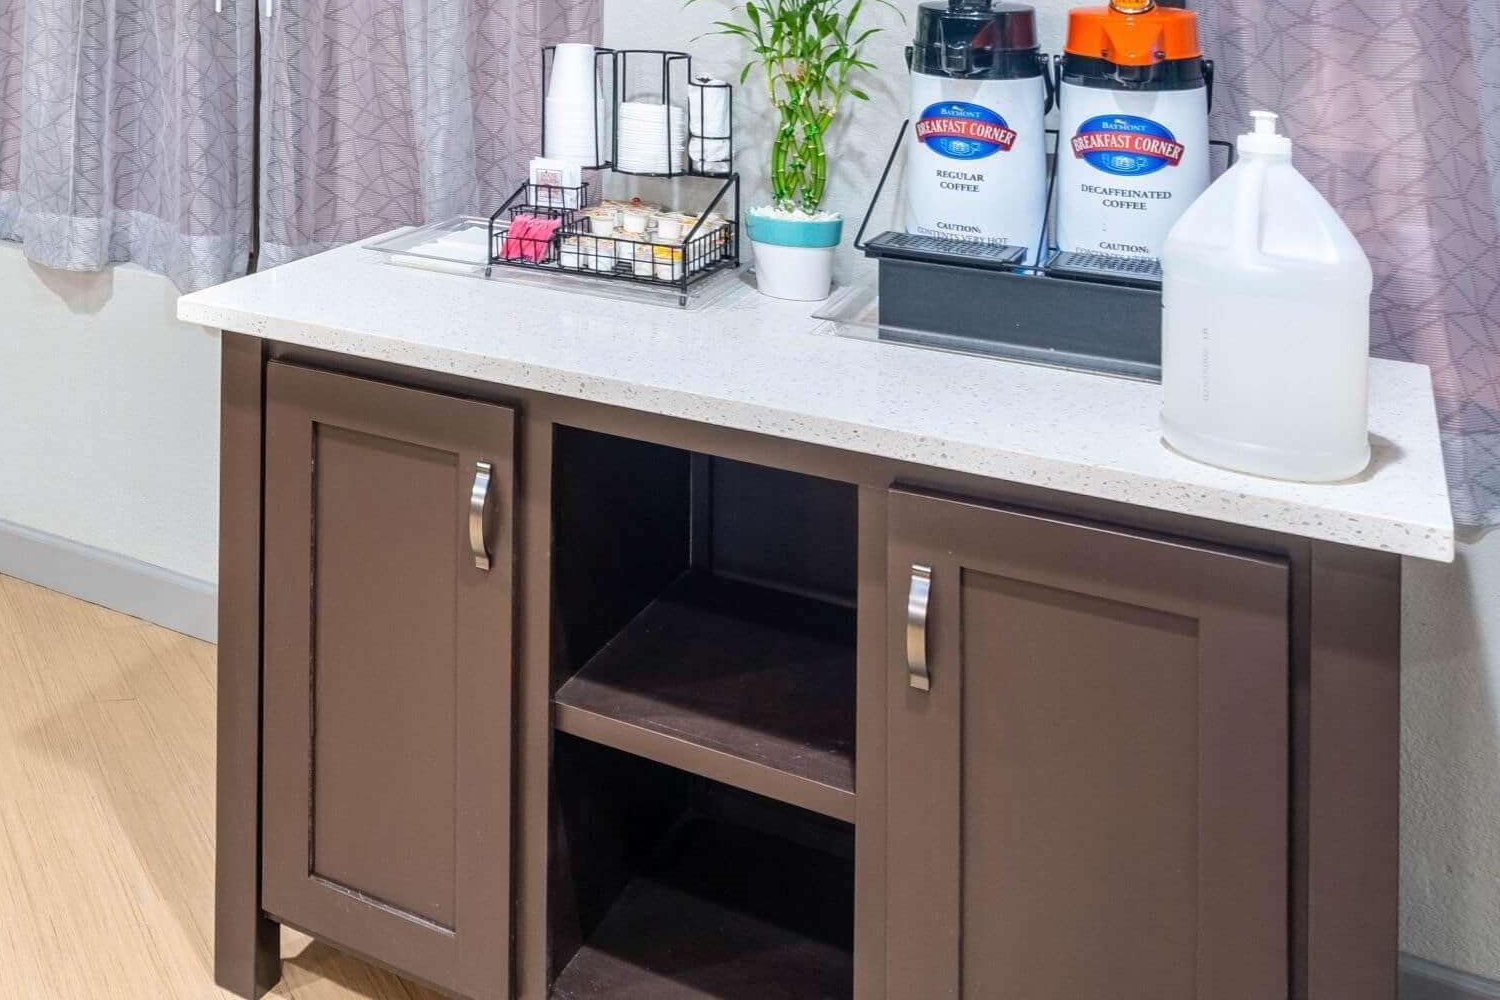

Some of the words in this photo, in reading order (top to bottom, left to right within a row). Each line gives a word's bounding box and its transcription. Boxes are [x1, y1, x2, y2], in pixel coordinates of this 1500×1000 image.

[940, 107, 981, 118] BAYMONT
[916, 119, 967, 137] BREAKFAST
[969, 122, 1014, 145] CORNER
[1102, 121, 1147, 131] BAYMONT
[1072, 134, 1132, 151] BREAKFAST
[1134, 136, 1182, 160] CORNER
[936, 169, 985, 182] REGULAR
[939, 181, 981, 193] COFFEE
[1081, 184, 1173, 200] DECAFFEINATED
[1102, 199, 1148, 211] COFFEE
[936, 221, 982, 233] CAUTION:
[1099, 241, 1149, 254] CAUTION:
